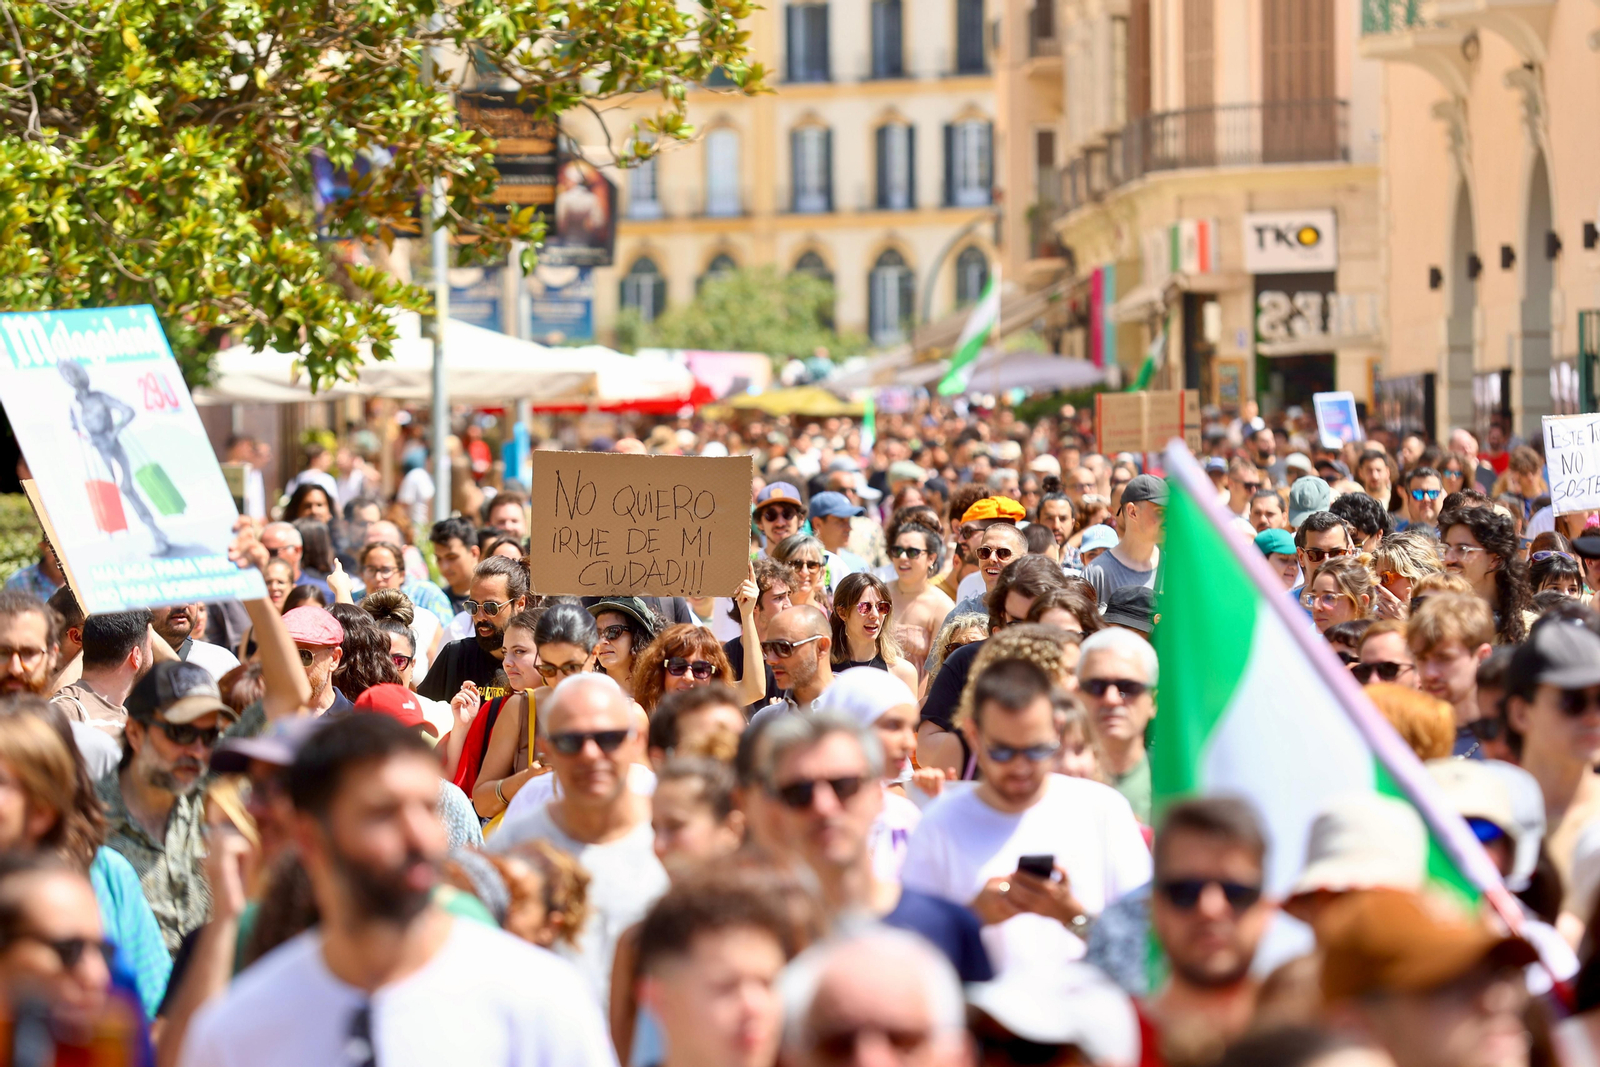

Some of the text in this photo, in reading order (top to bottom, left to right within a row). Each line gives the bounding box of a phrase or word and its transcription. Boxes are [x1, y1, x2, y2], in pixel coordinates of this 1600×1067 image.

[1253, 223, 1322, 251] TKO
[1550, 425, 1585, 449] ESTE
[1561, 451, 1584, 475] NO
[555, 469, 597, 520] NO
[626, 528, 661, 555] DE
[681, 526, 712, 558] MI
